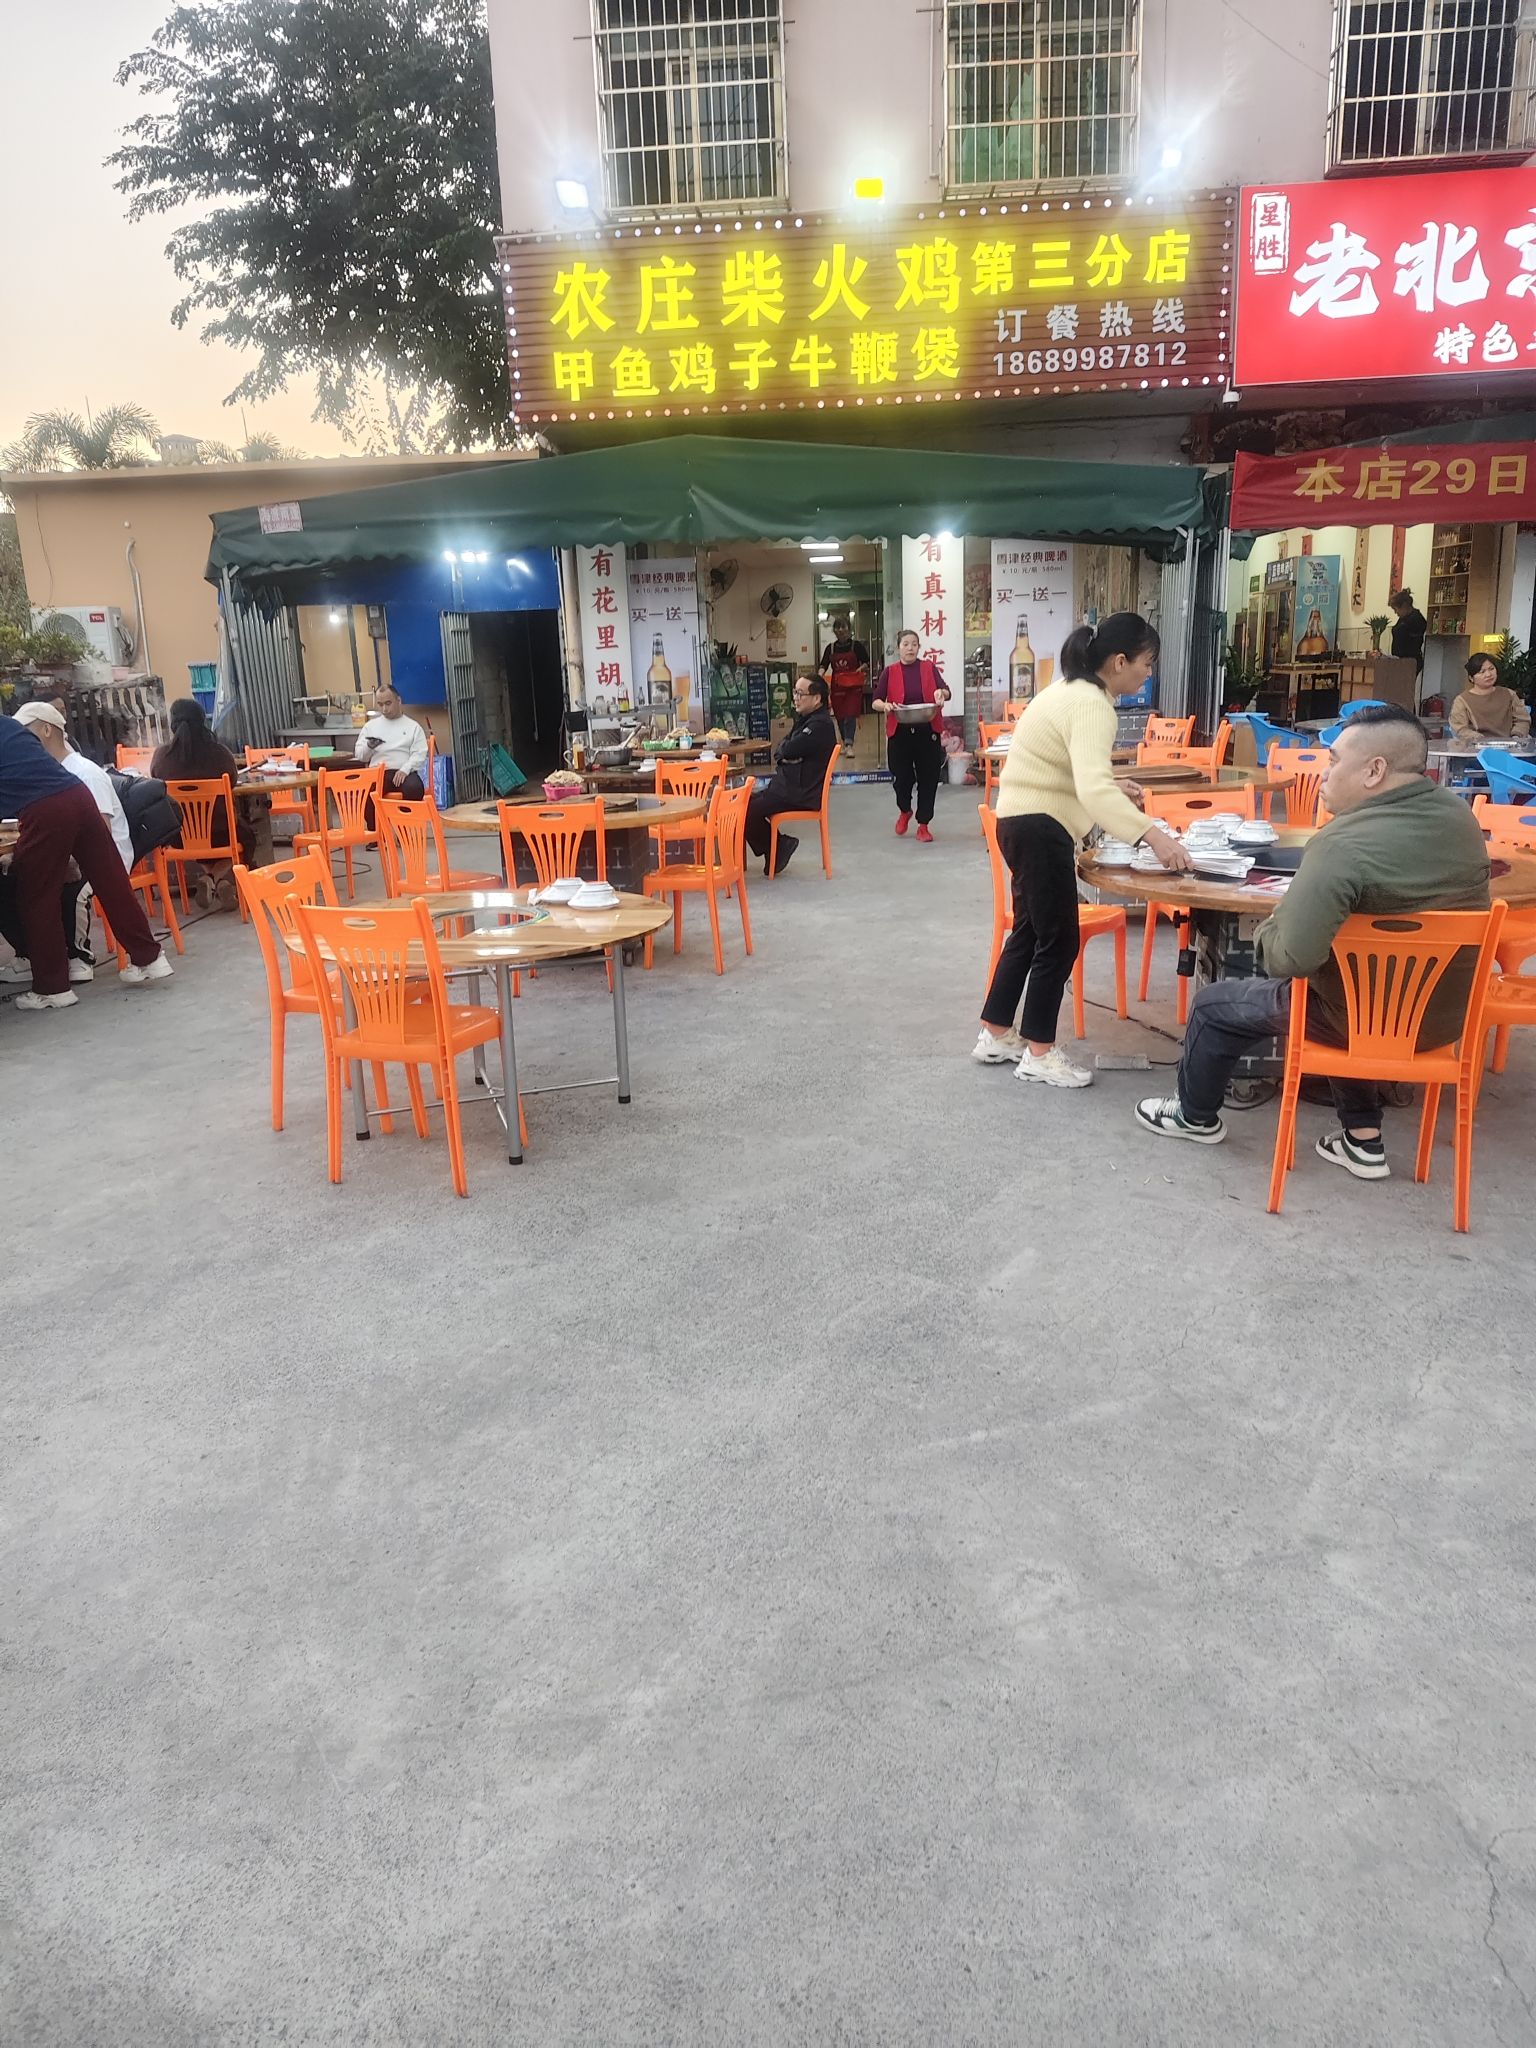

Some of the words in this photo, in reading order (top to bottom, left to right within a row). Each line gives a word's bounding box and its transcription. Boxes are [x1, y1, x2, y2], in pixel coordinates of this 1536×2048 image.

[971, 229, 1191, 296] 第三分店
[993, 298, 1187, 343] 订餐热线
[1433, 320, 1536, 364] 特色
[553, 327, 961, 402] 甲鱼鸡子牛鞭煲
[993, 342, 1187, 376] 18689987812
[631, 606, 698, 623] 买一送一
[997, 586, 1068, 603] 买一送一
[589, 548, 621, 687] 有花里胡
